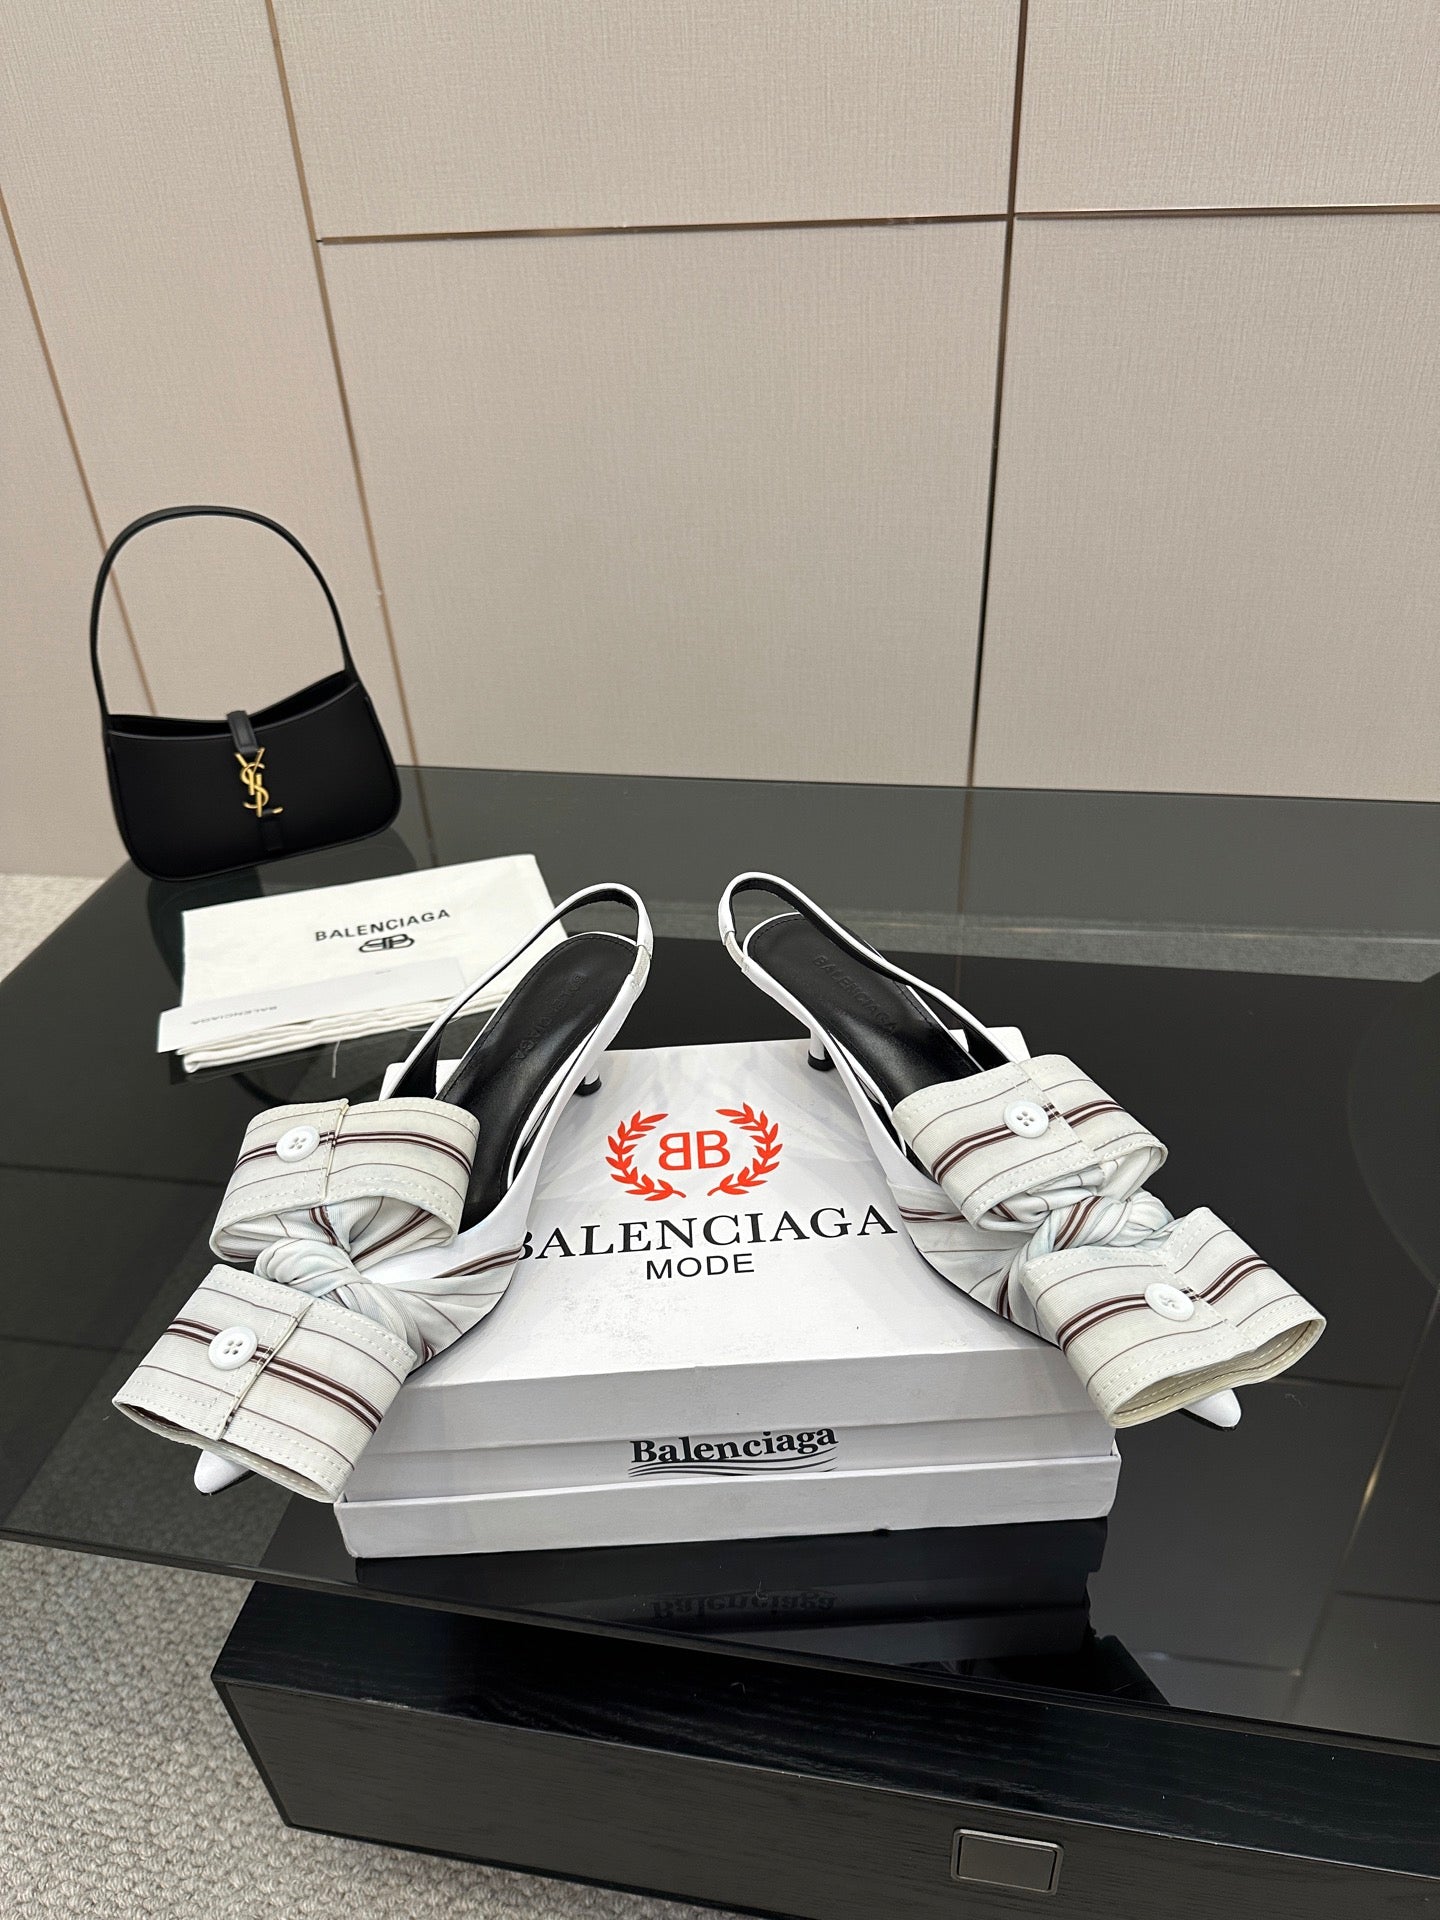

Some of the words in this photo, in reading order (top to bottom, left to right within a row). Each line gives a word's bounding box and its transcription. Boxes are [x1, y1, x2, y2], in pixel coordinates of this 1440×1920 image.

[315, 909, 451, 941] BALENCIAGA
[511, 973, 587, 1061] BALECIAGA
[646, 1253, 755, 1280] MODE
[630, 1428, 839, 1463] Balenciaga
